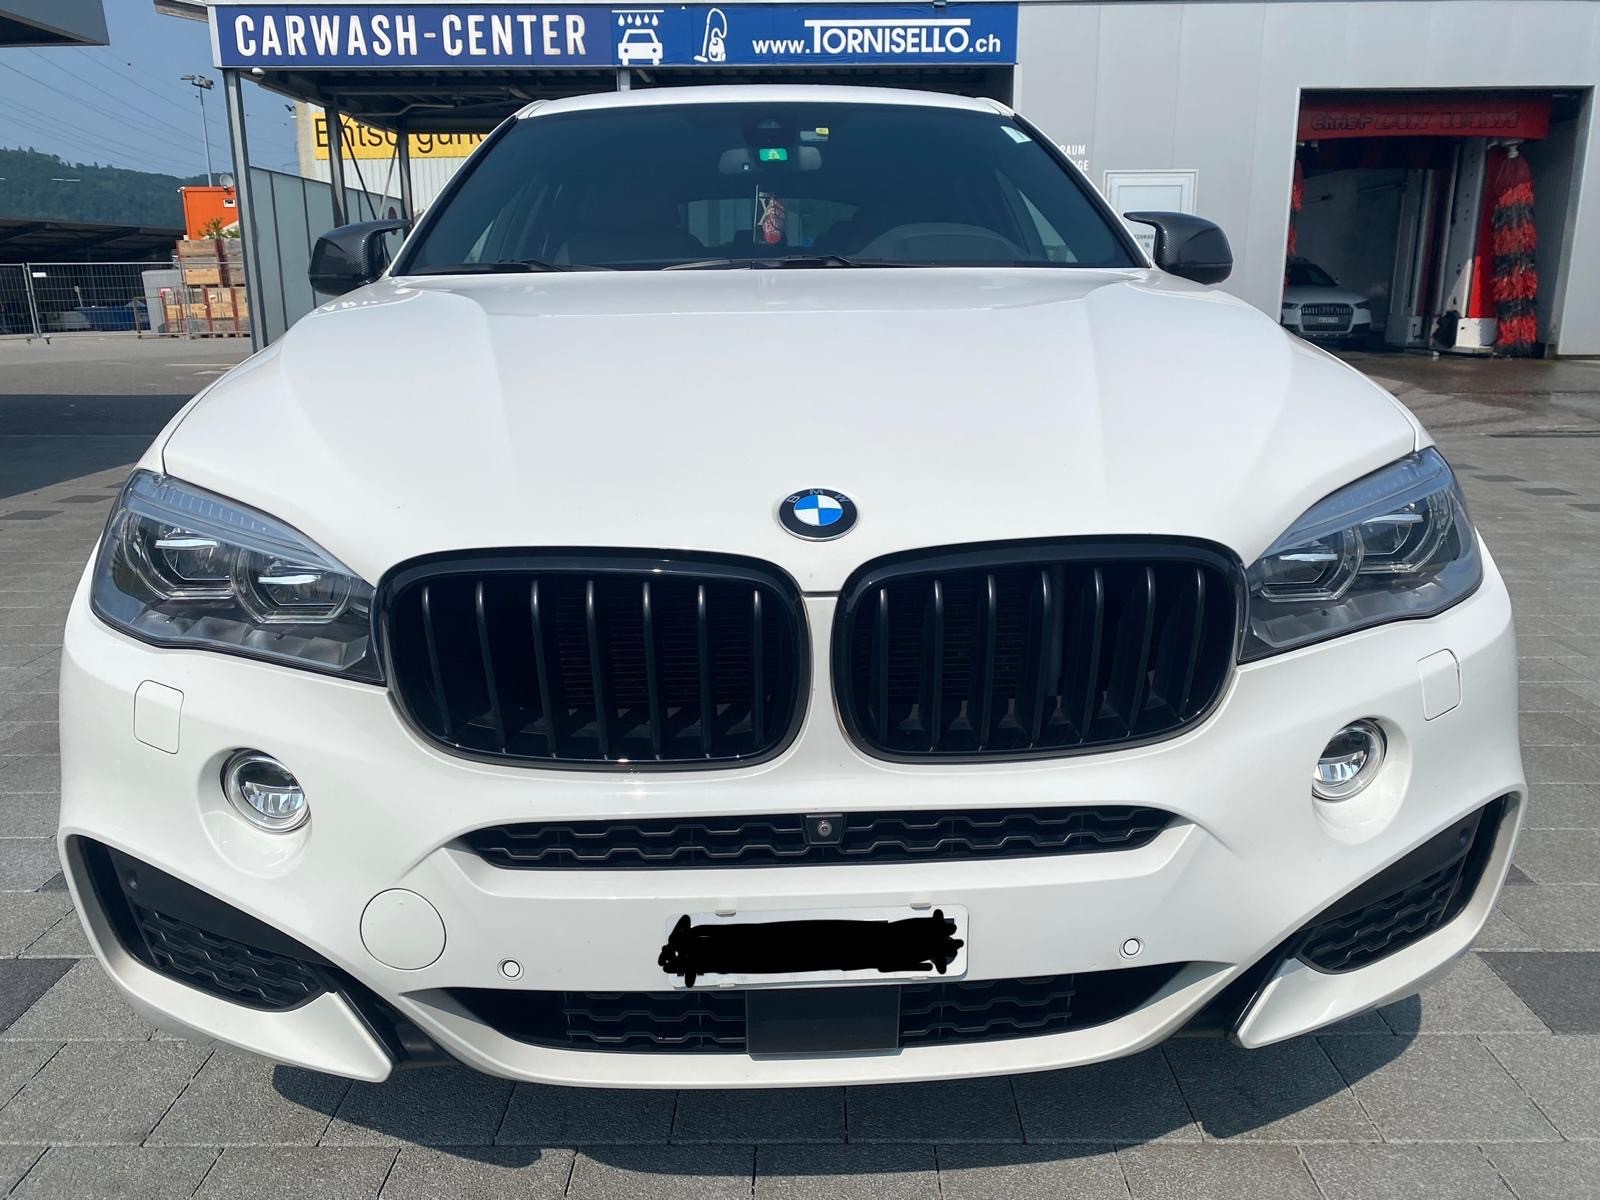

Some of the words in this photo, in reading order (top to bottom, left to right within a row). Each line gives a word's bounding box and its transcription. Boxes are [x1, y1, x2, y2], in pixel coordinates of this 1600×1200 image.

[235, 14, 587, 57] CARWASH-CENTER
[752, 18, 1001, 54] www.TORNISELLO.ch
[786, 489, 849, 503] BMW
